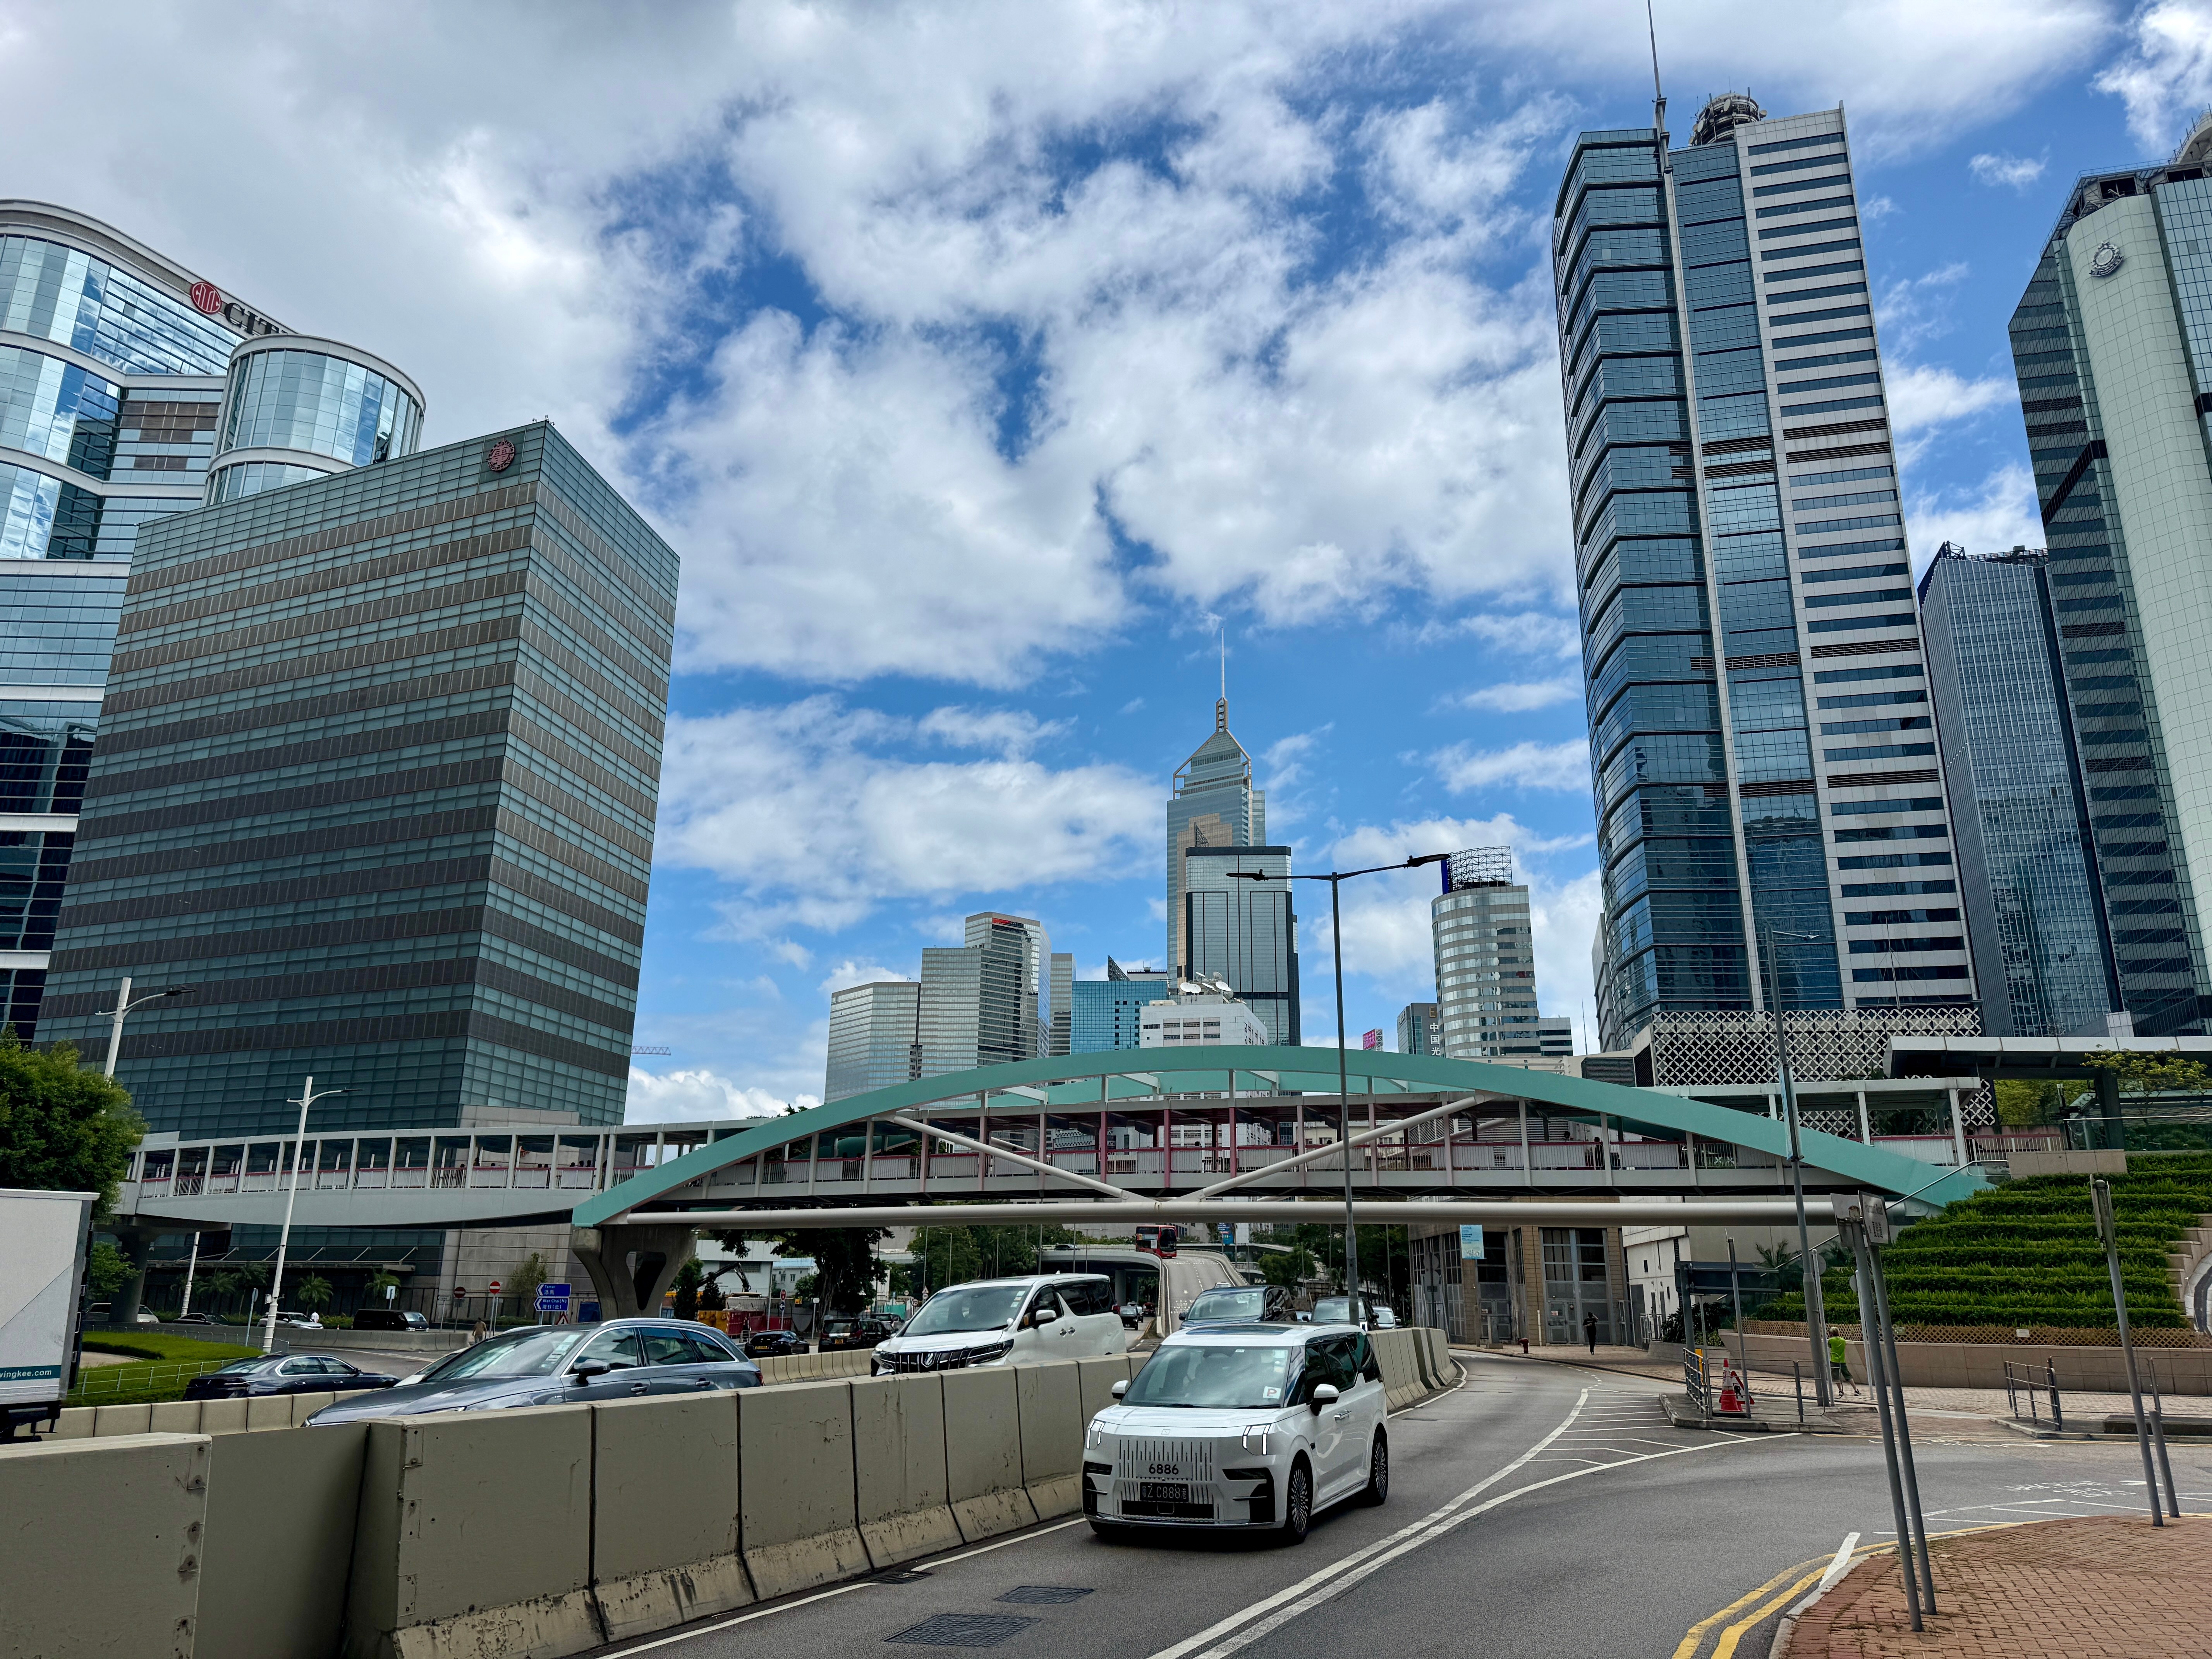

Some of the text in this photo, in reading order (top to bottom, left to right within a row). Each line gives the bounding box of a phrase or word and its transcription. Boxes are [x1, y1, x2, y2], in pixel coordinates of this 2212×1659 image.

[224, 302, 288, 335] CIT
[1430, 1023, 1441, 1056] 中国光
[1267, 1388, 1277, 1397] P
[1149, 1463, 1179, 1475] 6886
